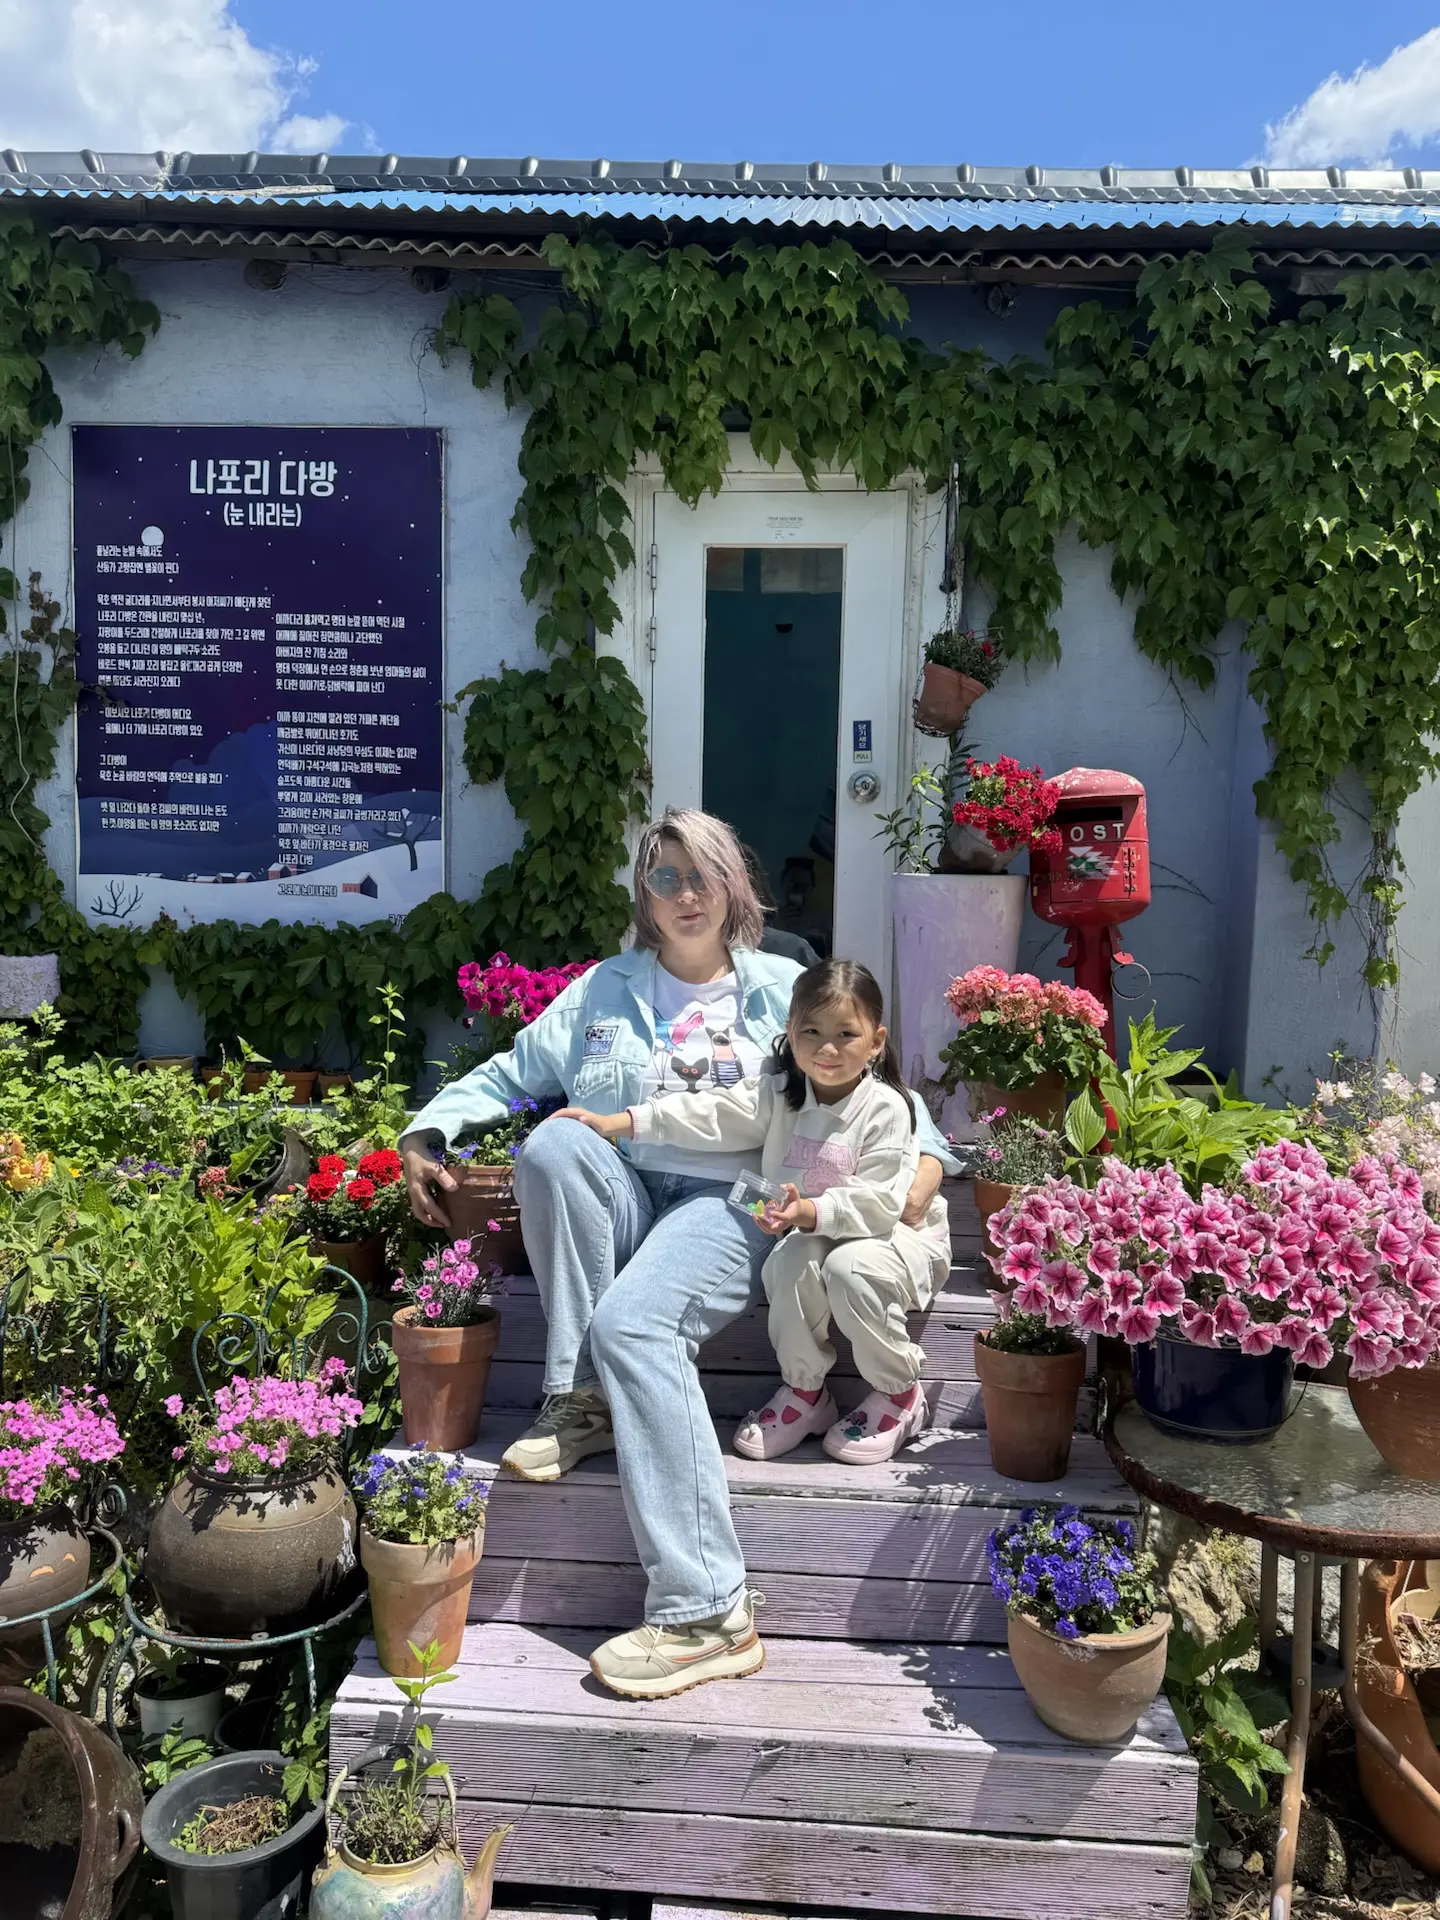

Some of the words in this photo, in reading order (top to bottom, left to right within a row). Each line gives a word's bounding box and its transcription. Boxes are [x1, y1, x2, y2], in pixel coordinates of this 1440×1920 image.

[189, 459, 271, 496] 나포리
[279, 460, 338, 497] 다방
[223, 502, 245, 527] (눈
[248, 502, 303, 528] 내리는)
[122, 546, 135, 557] 눈발
[137, 546, 162, 557] 속에서도
[97, 594, 109, 605] 묵호
[111, 594, 124, 605] 역전
[125, 595, 150, 606] 굴다리를
[152, 595, 190, 606] 지나면서부터
[192, 596, 204, 607] 봉사
[206, 596, 233, 607] 아저씨가
[235, 597, 256, 607] 애타게
[258, 597, 271, 608] 찾던
[98, 611, 116, 621] 나포리
[118, 611, 137, 622] 다방은
[139, 611, 157, 622] 간판을
[159, 612, 179, 622] 내린지
[332, 615, 345, 626] 명태
[377, 616, 390, 627] 먹던
[392, 617, 405, 628] 시절
[98, 627, 123, 638] 지팡이를
[179, 628, 204, 639] 나포리를
[205, 628, 219, 639] 찾아
[220, 629, 234, 640] 가던
[235, 629, 241, 640] 그
[243, 629, 249, 640] 길
[251, 629, 265, 640] 위엔
[276, 630, 297, 641] 어깨에
[355, 632, 382, 644] 고단했던
[117, 643, 129, 654] 들고
[131, 644, 150, 654] 다니던
[202, 645, 220, 655] 소리도
[276, 646, 303, 657] 아버지의
[305, 647, 311, 658] 잔
[313, 647, 326, 658] 기침
[328, 648, 348, 659] 소리와
[118, 659, 130, 670] 한복
[132, 660, 145, 670] 치마
[146, 660, 159, 670] 꼬리
[222, 661, 243, 672] 단장한
[276, 663, 290, 673] 명태
[292, 663, 319, 674] 덕장에서
[321, 664, 328, 675] 언
[329, 664, 348, 675] 손으로
[350, 665, 368, 676] 청춘을
[370, 666, 383, 676] 보낸
[385, 666, 411, 677] 엄마들의
[413, 667, 426, 678] 삶이
[133, 676, 159, 687] 사라진지
[161, 676, 180, 687] 오래다
[276, 679, 282, 689] 못
[284, 679, 297, 690] 다한
[299, 680, 326, 691] 이야기로
[328, 681, 354, 691] 담벼락에
[356, 681, 370, 692] 피어
[372, 682, 384, 693] 난다
[151, 708, 171, 719] 다방이
[172, 709, 191, 719] 어디요
[344, 714, 357, 724] 있던
[126, 724, 132, 734] 더
[134, 724, 146, 734] 가야
[148, 724, 167, 735] 나포리
[168, 725, 188, 735] 다방이
[305, 729, 338, 740] 뛰어다니던
[340, 730, 359, 740] 호기도
[857, 723, 868, 749] 당기세요
[278, 744, 297, 754] 귀신이
[299, 744, 326, 755] 나온다던
[375, 747, 395, 758] 이제는
[397, 748, 417, 759] 없지만
[100, 754, 106, 765] 그
[107, 755, 127, 765] 다방이
[306, 761, 340, 771] 구석구석에
[341, 762, 373, 773] 자국눈처럼
[99, 770, 111, 781] 묵호
[126, 771, 146, 781] 바람의
[147, 772, 167, 782] 언덕에
[169, 772, 193, 783] 추억으로
[278, 775, 302, 786] 슬프도록
[304, 776, 330, 787] 아름다운
[332, 777, 351, 788] 시간들
[299, 792, 312, 802] 김이
[314, 793, 340, 803] 서려있는
[342, 793, 362, 804] 창문에
[117, 802, 136, 813] 나갔다
[137, 803, 149, 813] 돌아
[151, 803, 157, 814] 온
[159, 804, 177, 814] 김씨의
[201, 805, 214, 815] 나는
[215, 805, 228, 816] 돈도
[278, 807, 310, 818] 그리움이란
[312, 808, 332, 819] 손가락
[333, 809, 353, 819] 글씨가
[388, 811, 401, 821] 있다
[1070, 822, 1125, 843] OST
[279, 838, 291, 849] 묵호
[323, 840, 347, 850] 풍경으로
[279, 854, 298, 865] 나포리
[300, 855, 313, 865] 다방
[315, 884, 338, 898] 내린다
